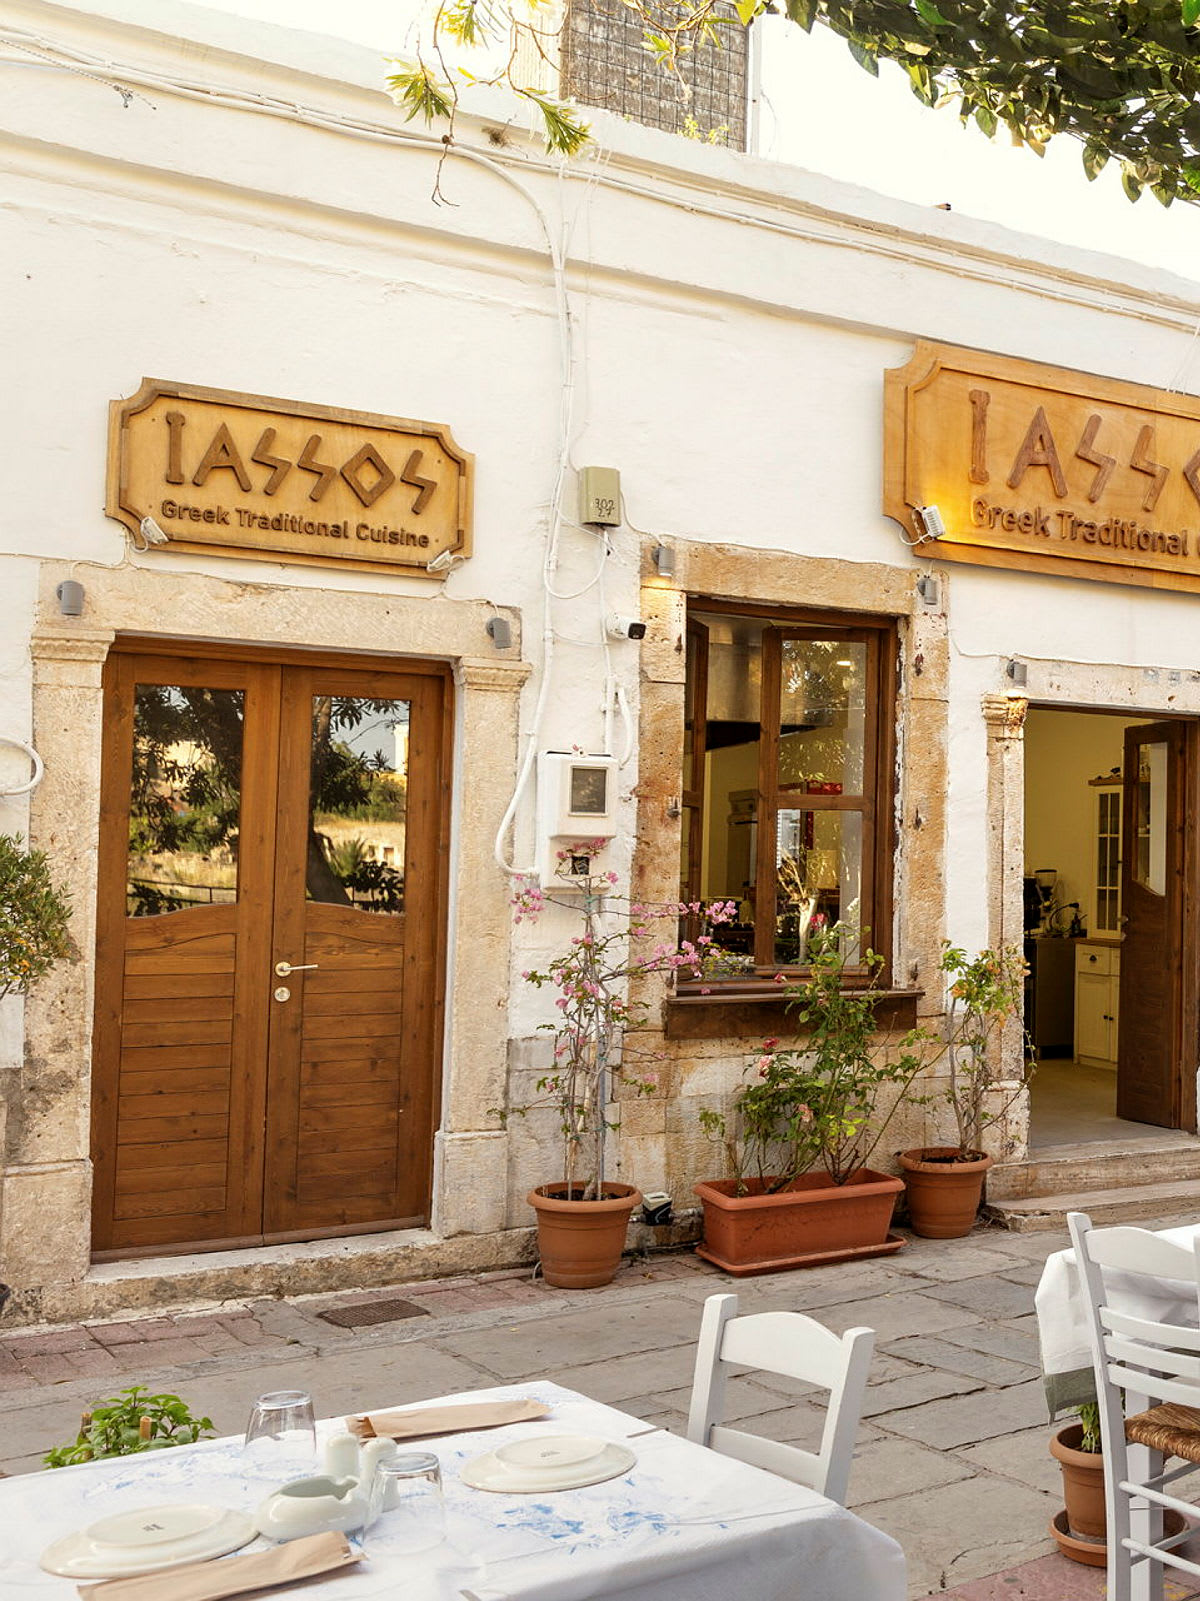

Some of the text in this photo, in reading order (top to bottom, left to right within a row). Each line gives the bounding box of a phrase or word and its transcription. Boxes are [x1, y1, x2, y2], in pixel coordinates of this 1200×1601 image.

[165, 410, 438, 515] IASSOS
[161, 499, 430, 548] Greek Traditional Cuisine
[972, 499, 1051, 538] Greek
[1054, 509, 1189, 557] Traditional
